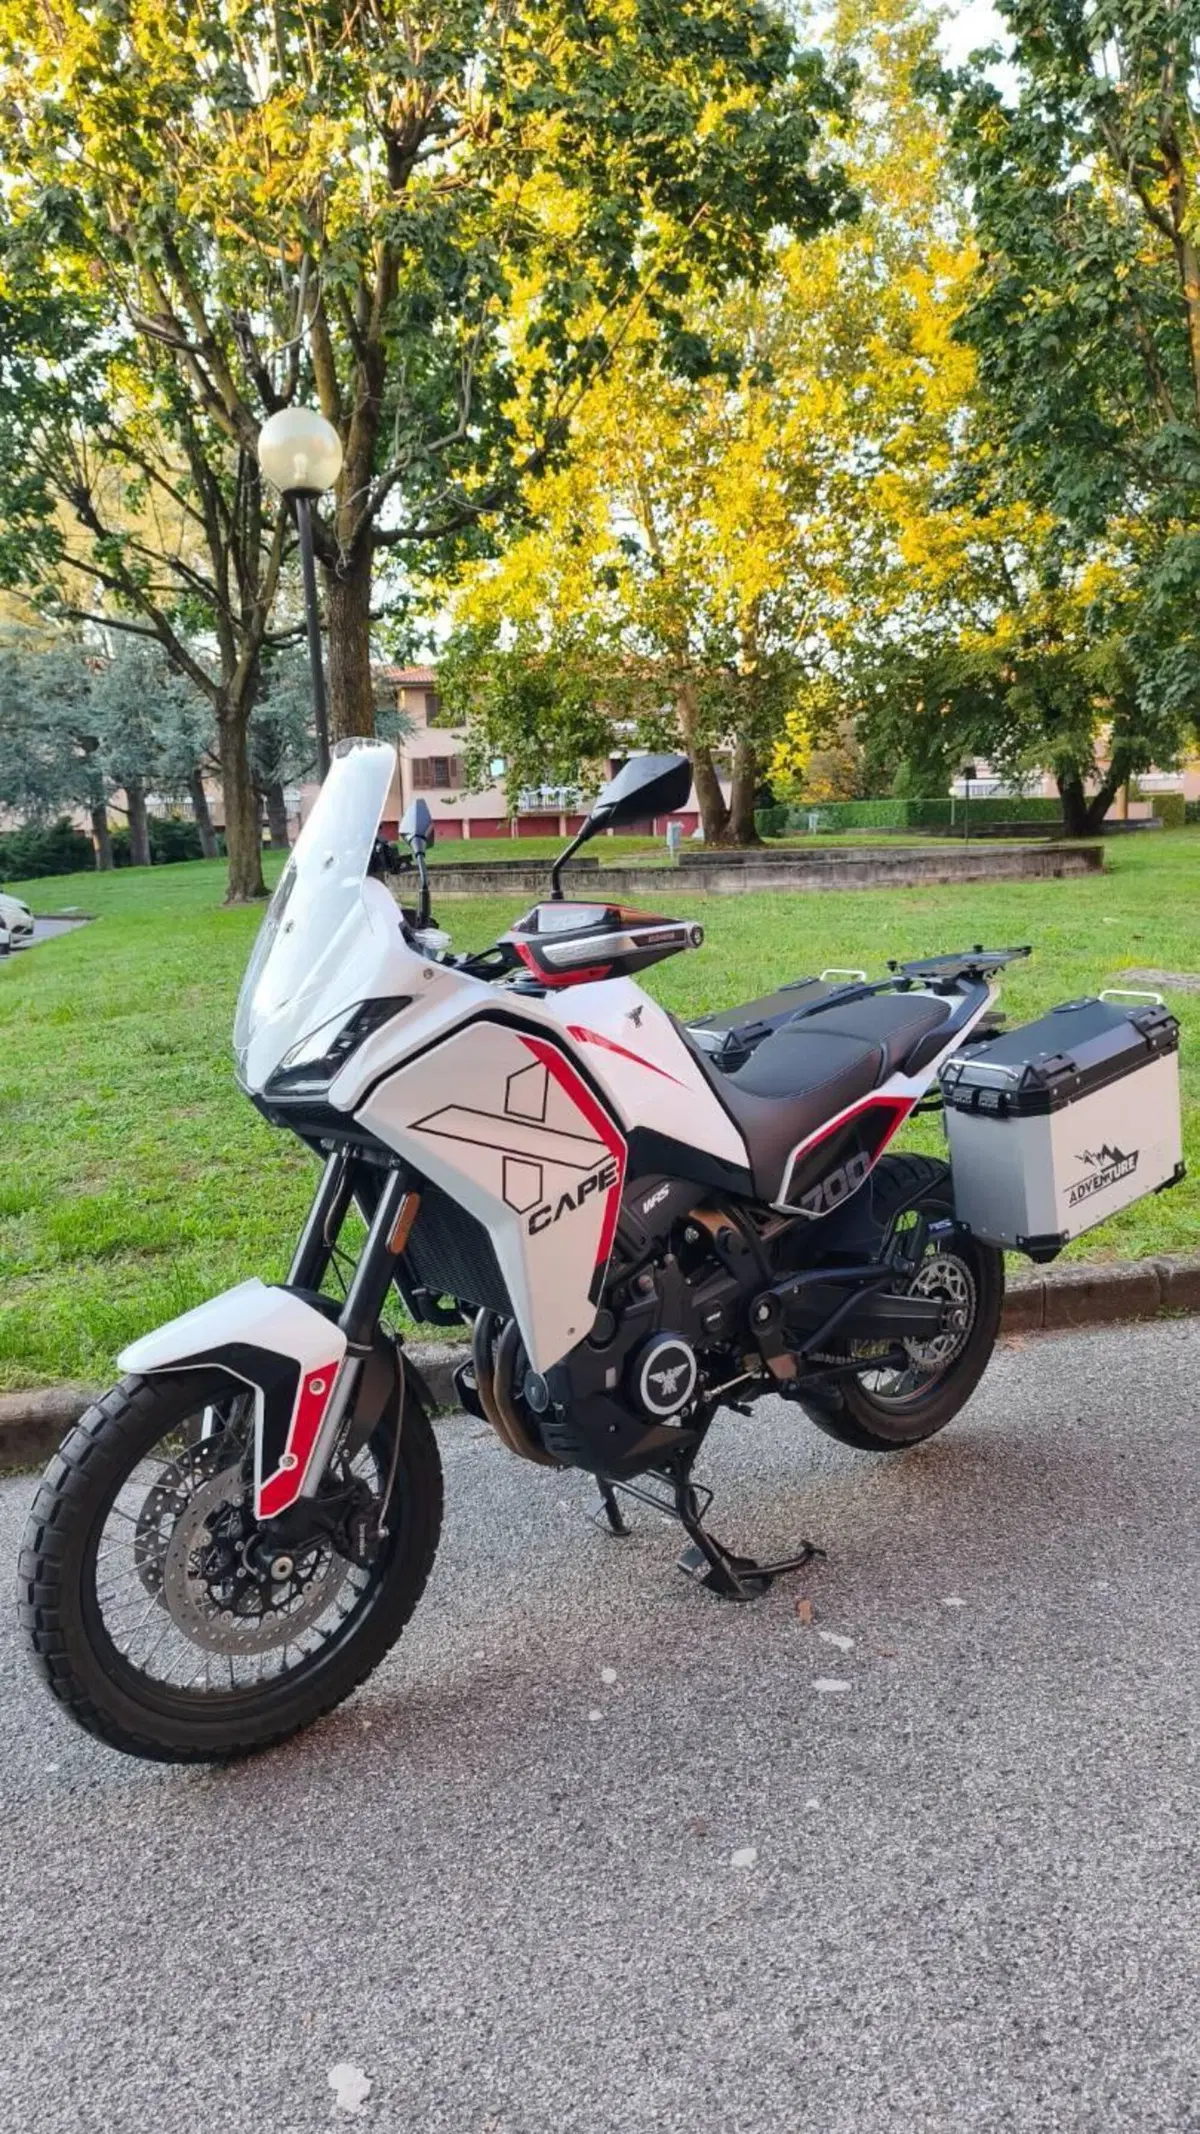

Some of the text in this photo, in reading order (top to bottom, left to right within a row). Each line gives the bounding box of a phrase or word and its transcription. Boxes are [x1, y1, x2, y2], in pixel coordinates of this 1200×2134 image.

[529, 1160, 618, 1236] CAPE
[801, 1151, 870, 1212] 700
[1069, 1156, 1135, 1204] ADVENTURE
